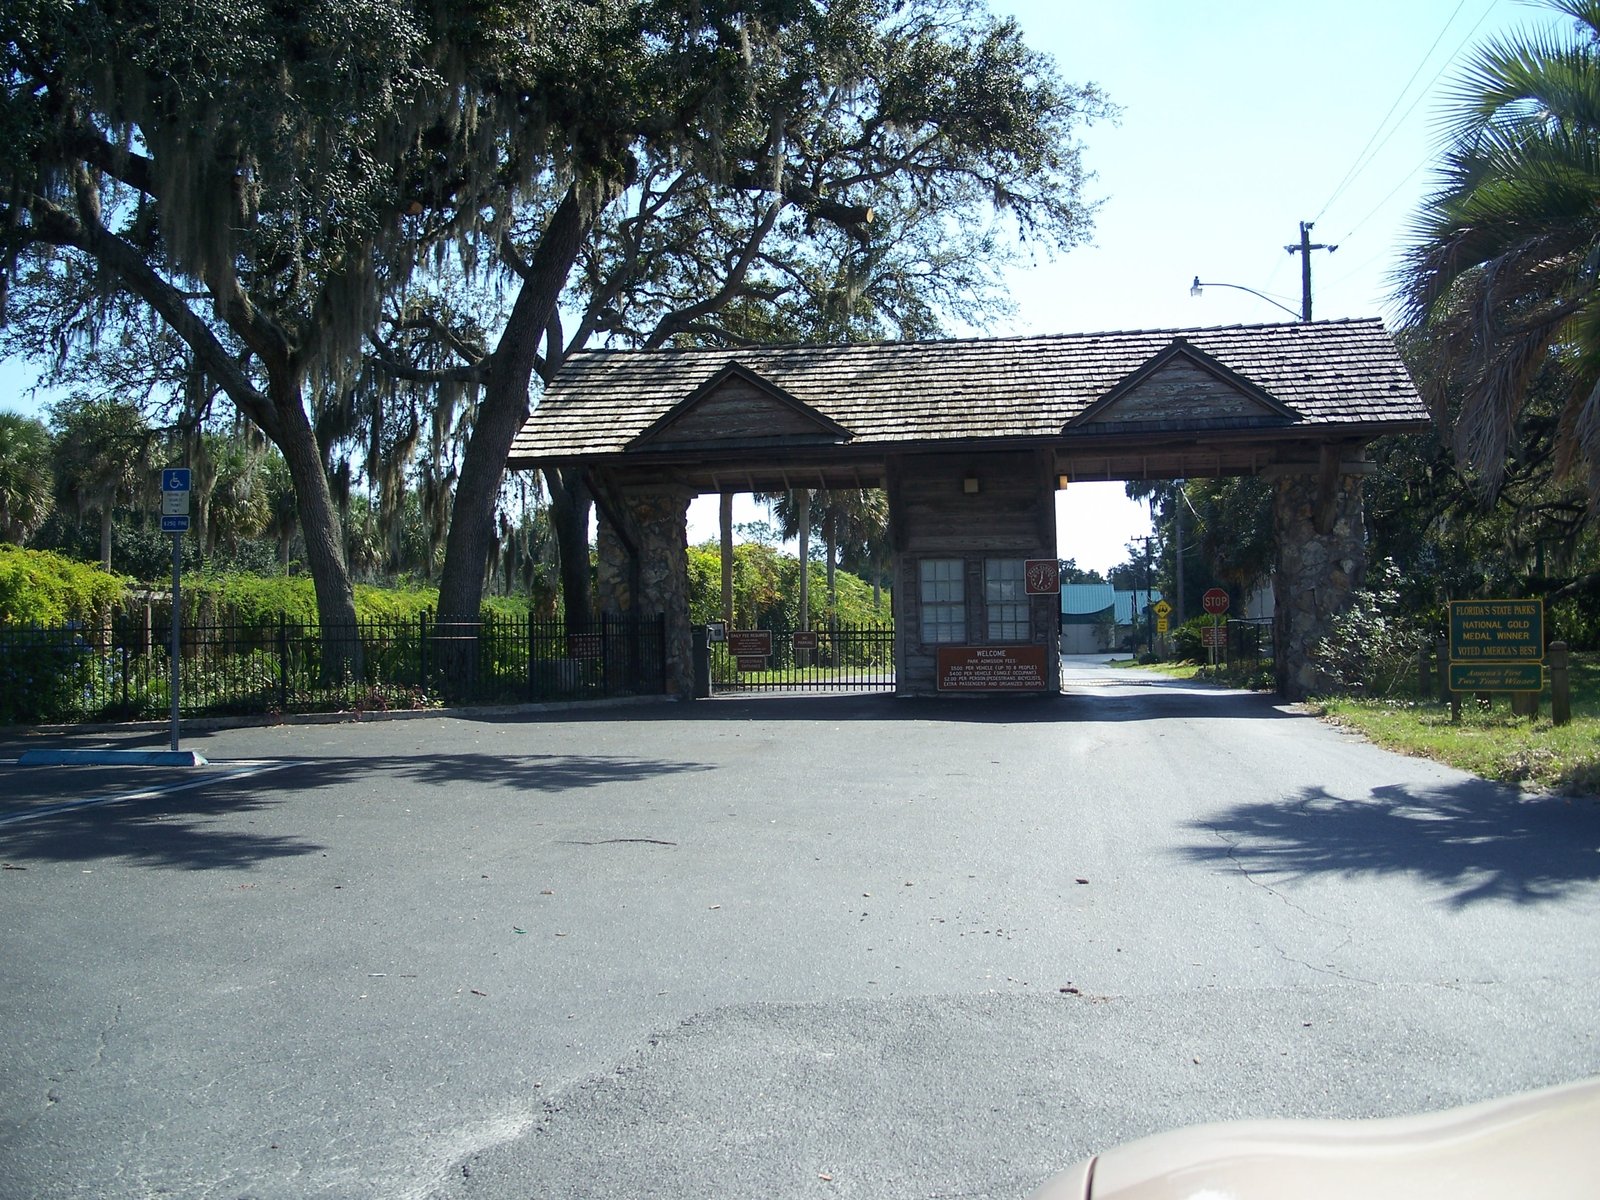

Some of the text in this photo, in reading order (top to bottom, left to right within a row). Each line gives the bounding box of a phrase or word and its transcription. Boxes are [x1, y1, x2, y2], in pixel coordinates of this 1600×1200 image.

[1205, 597, 1227, 606] STOP
[1456, 605, 1536, 615] FLORIDA'S STATE PARKS
[1462, 621, 1502, 629] NATIONAL
[1462, 632, 1530, 640] MEDAL WINNER
[1458, 646, 1537, 655] VOTED AMERICA'S BEST
